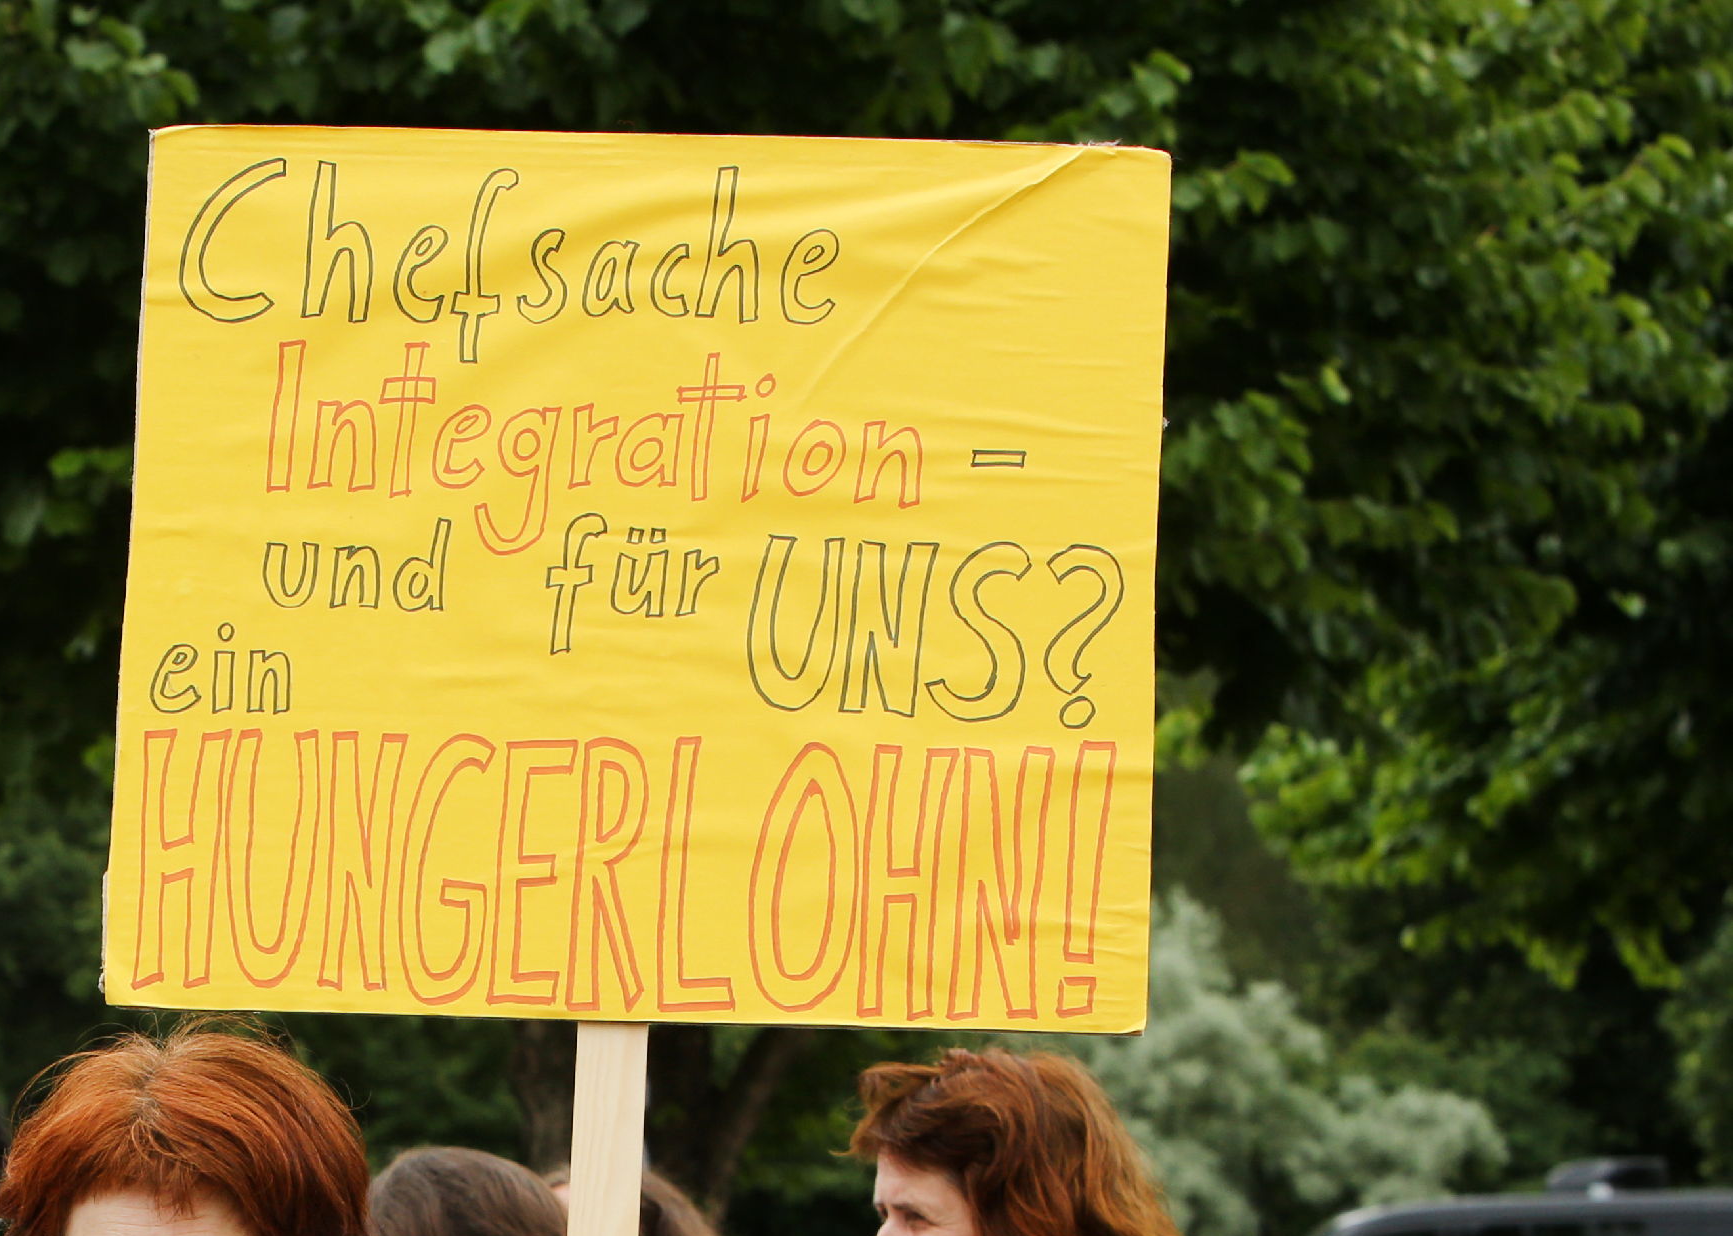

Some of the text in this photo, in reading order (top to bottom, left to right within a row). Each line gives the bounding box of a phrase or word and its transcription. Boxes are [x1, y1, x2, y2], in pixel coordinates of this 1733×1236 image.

[178, 157, 840, 363] Chefsache
[266, 341, 922, 556] Integration
[149, 623, 292, 714] ein
[263, 512, 1124, 730] und für UNS?
[132, 729, 1117, 1020] HUNGERLOHN!
